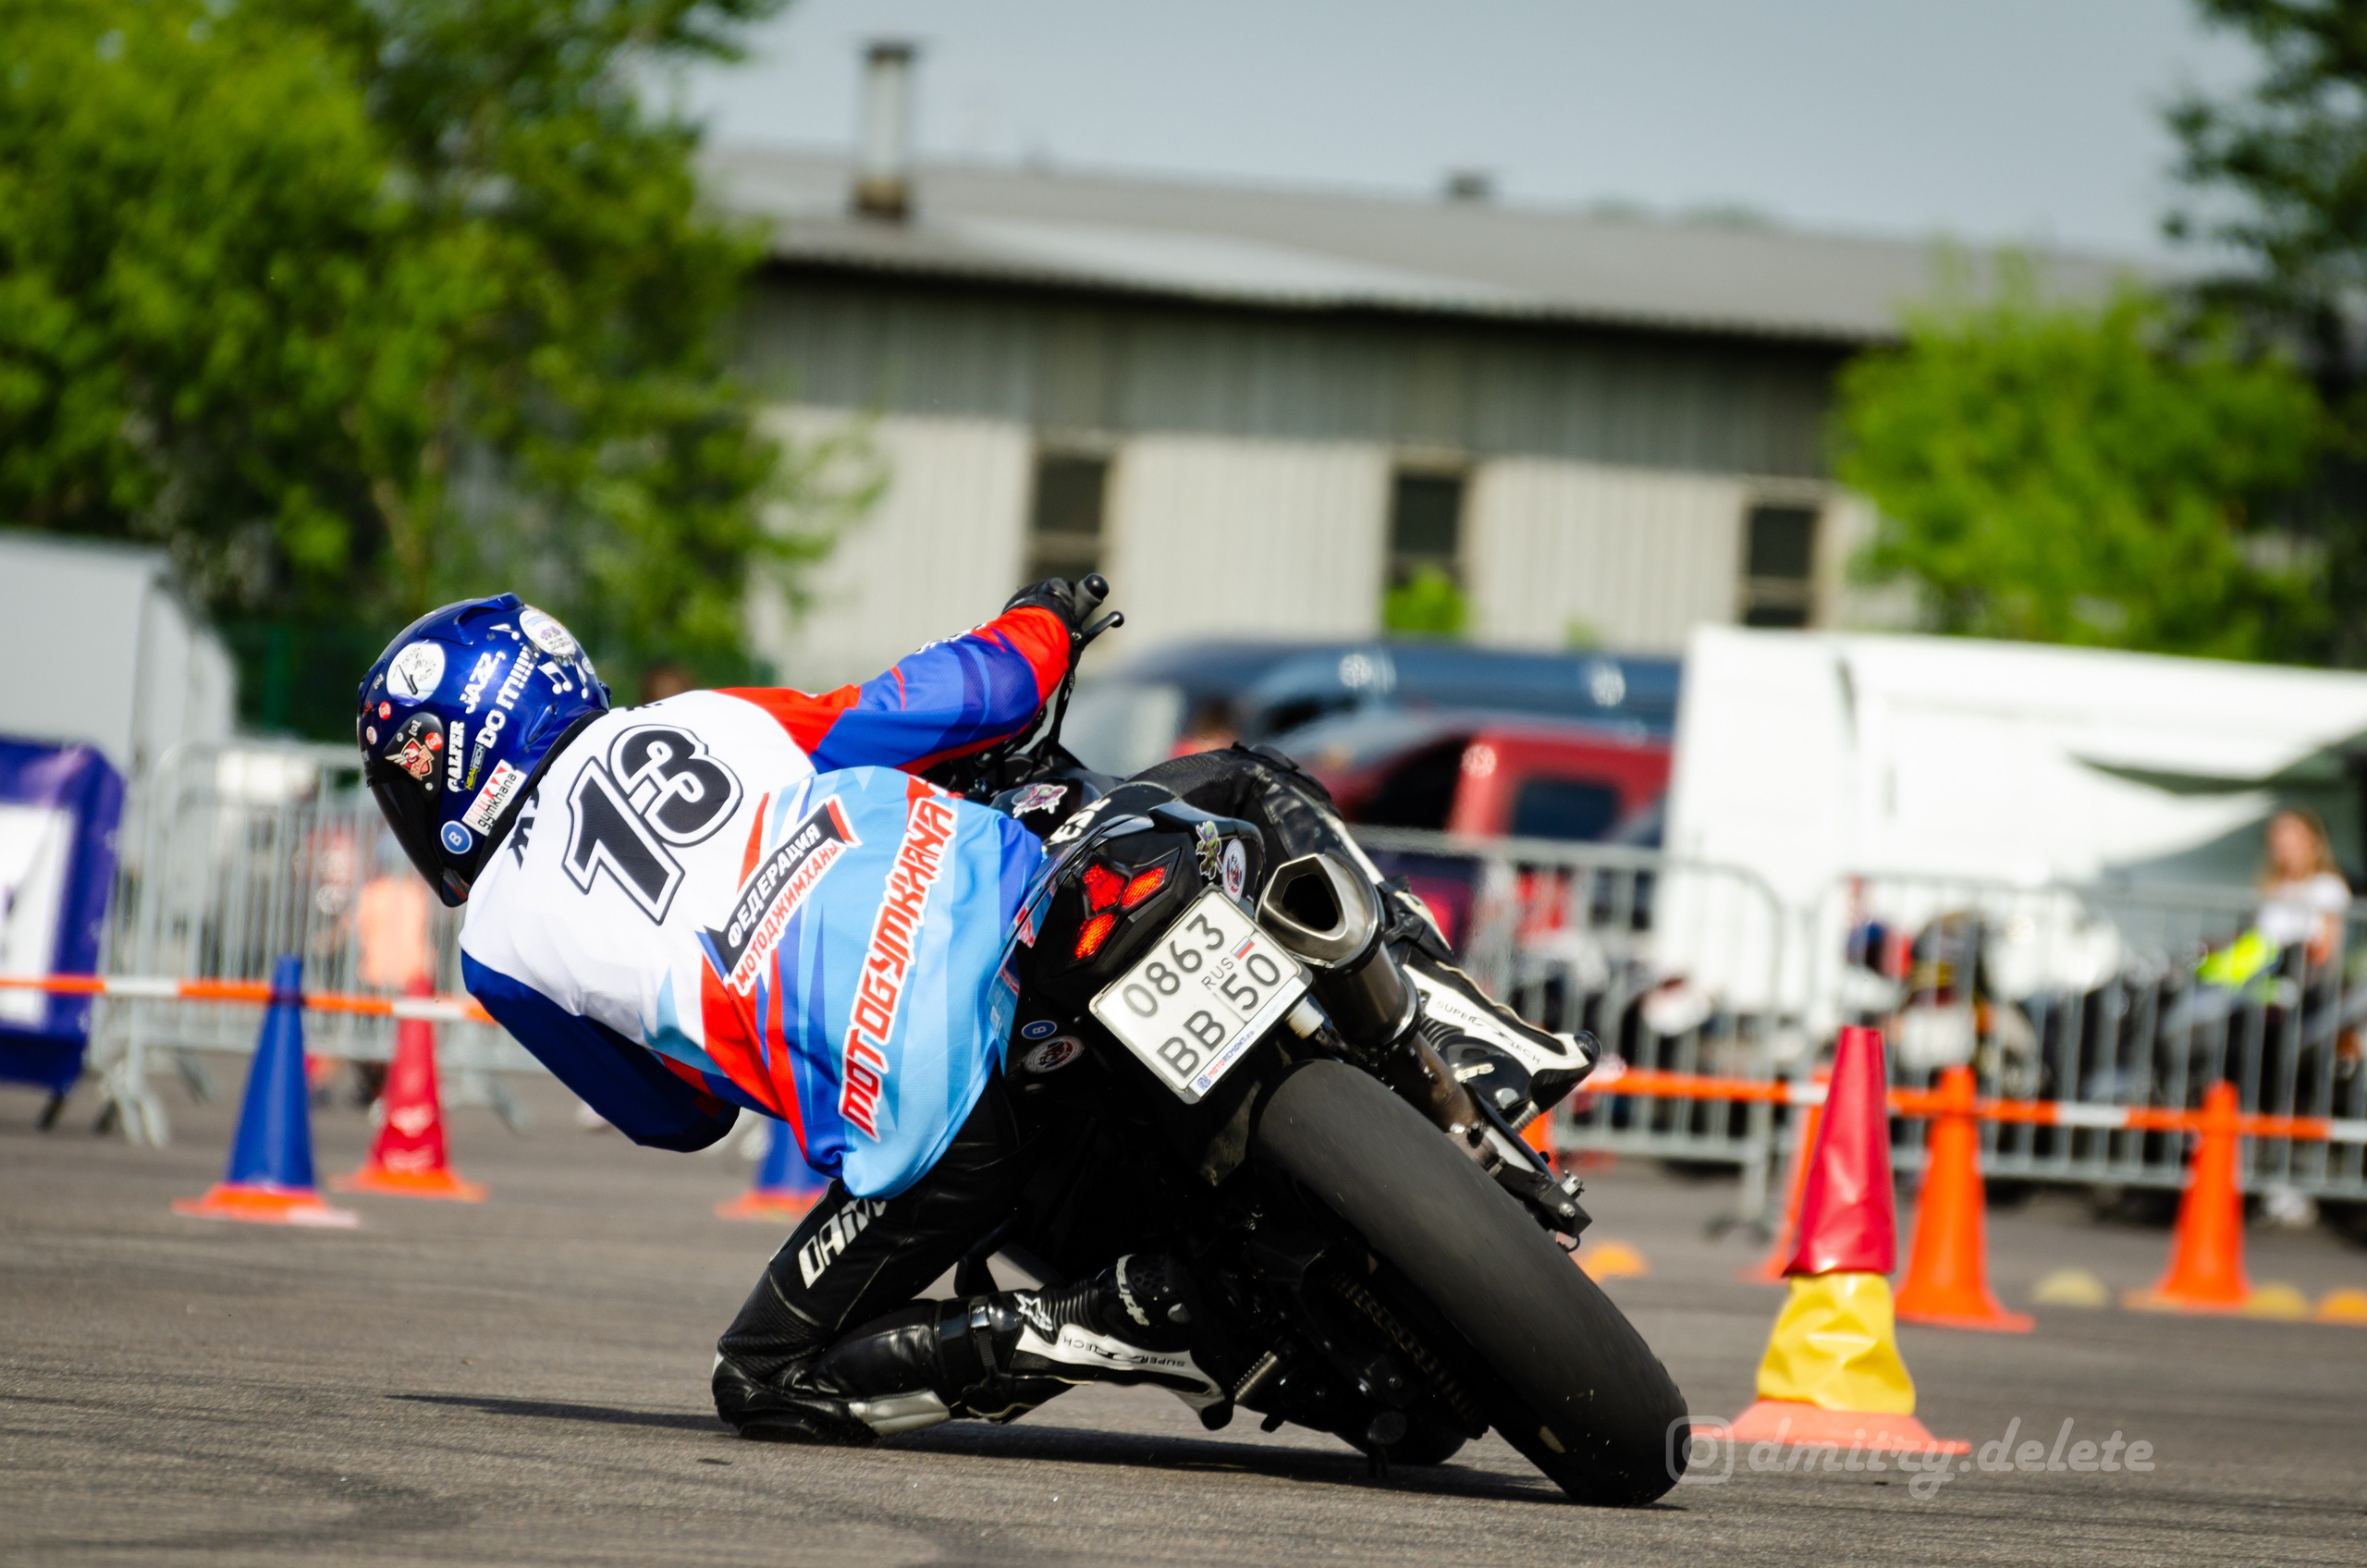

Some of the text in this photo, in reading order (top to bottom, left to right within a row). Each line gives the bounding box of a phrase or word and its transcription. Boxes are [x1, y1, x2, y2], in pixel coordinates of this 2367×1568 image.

[475, 709, 506, 749] DO
[478, 773, 517, 830] gymkhana
[562, 724, 742, 925] 13
[728, 822, 820, 948] ФЕДЕРАЦИЯ
[736, 842, 840, 991] МОТОДЖИМХАНЫ
[842, 800, 954, 1140] MOTOGYMKHANA
[1122, 913, 1225, 1018] 0863
[1201, 957, 1234, 990] RUS
[1220, 953, 1281, 1011] 50
[1141, 1355, 1185, 1367] SUPER
